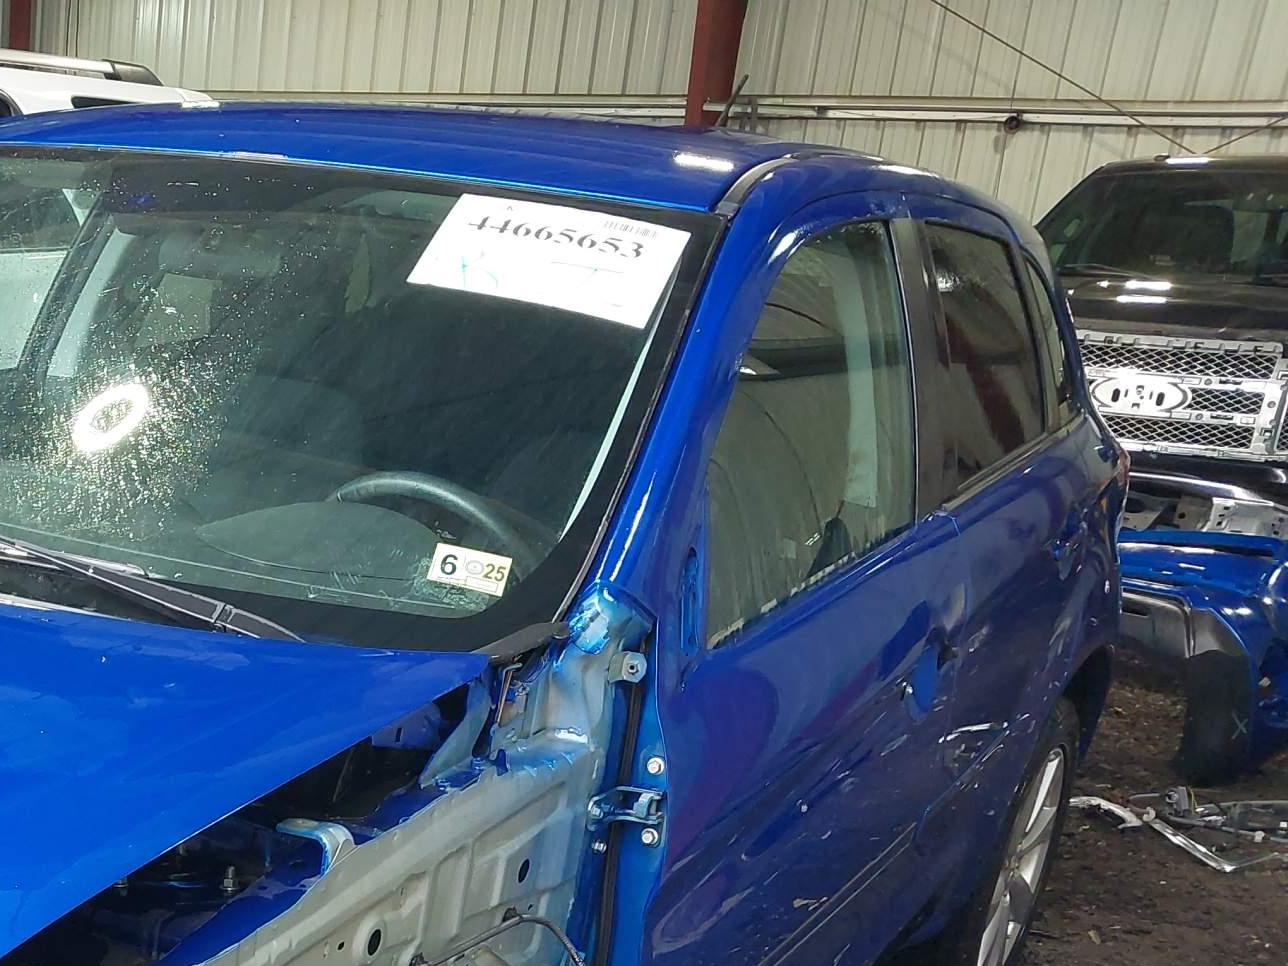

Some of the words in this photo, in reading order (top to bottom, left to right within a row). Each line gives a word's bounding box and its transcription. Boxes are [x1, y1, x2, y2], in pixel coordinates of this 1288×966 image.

[468, 215, 644, 258] 44665653
[440, 554, 458, 575] 6
[483, 563, 506, 582] 25
